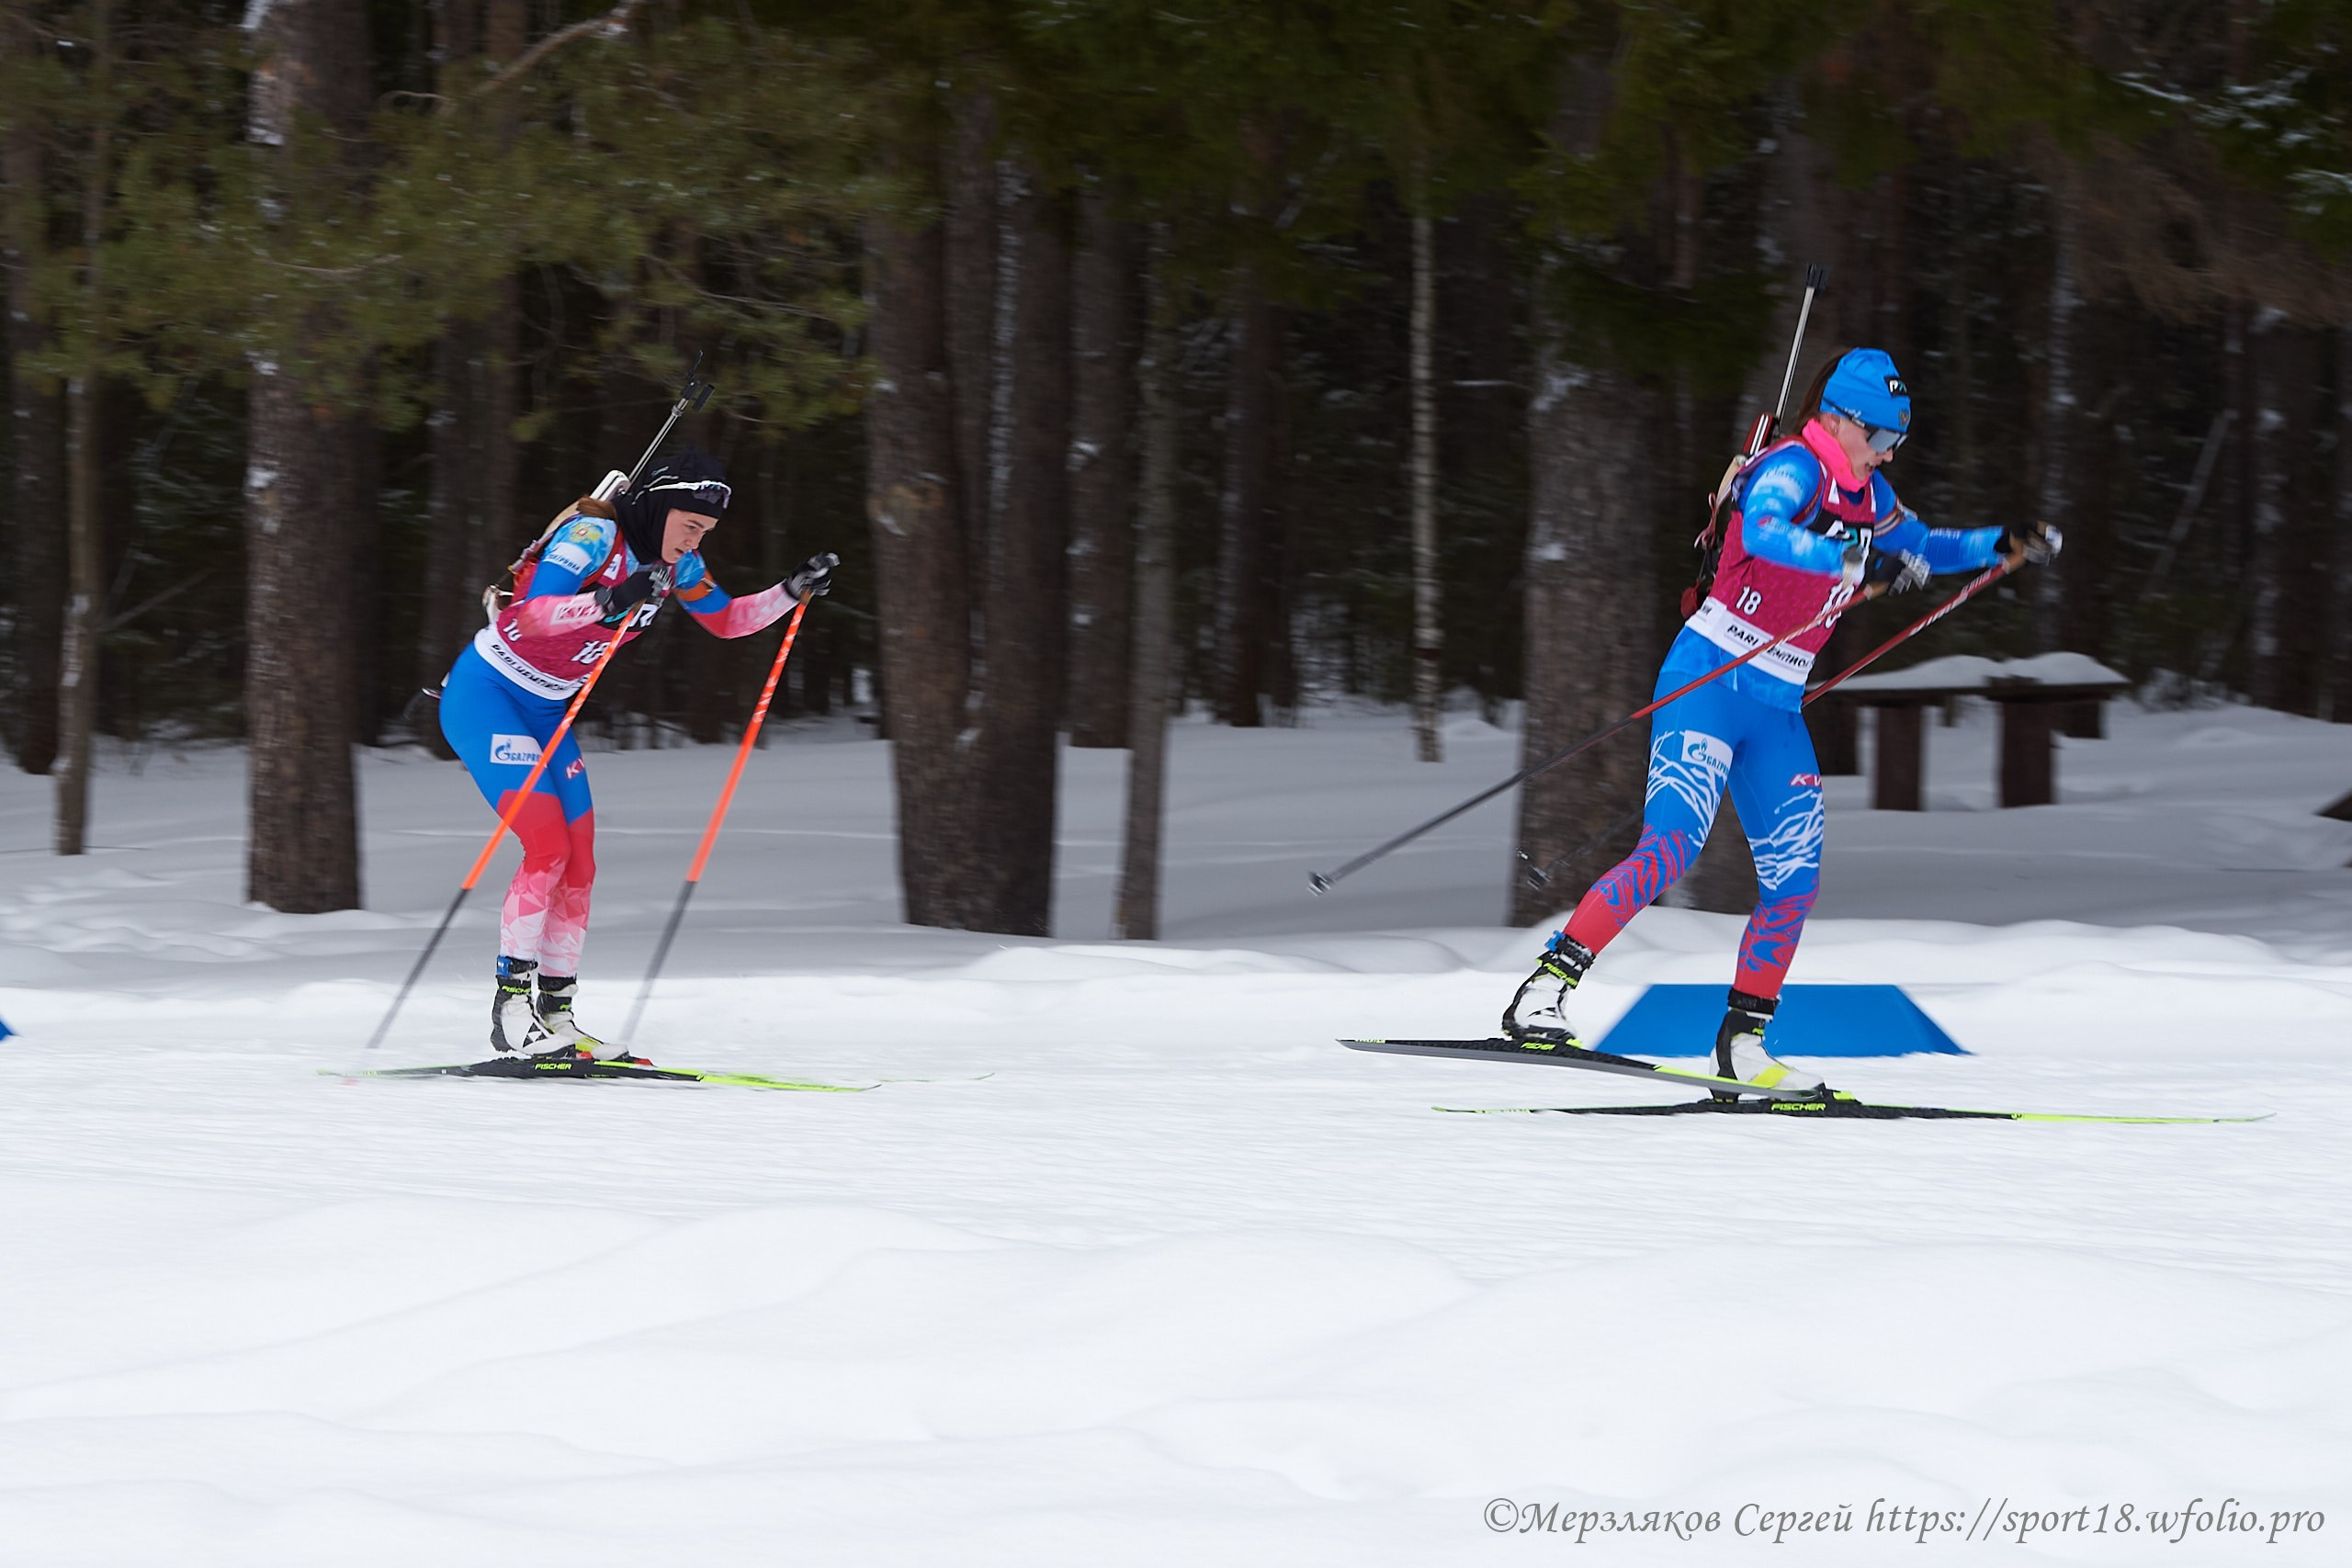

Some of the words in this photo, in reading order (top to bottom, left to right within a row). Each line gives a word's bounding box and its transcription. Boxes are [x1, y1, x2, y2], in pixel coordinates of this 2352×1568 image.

[1735, 585, 1762, 615] 18
[1727, 624, 1759, 646] PARI
[1770, 1102, 1826, 1111] FISCHER
